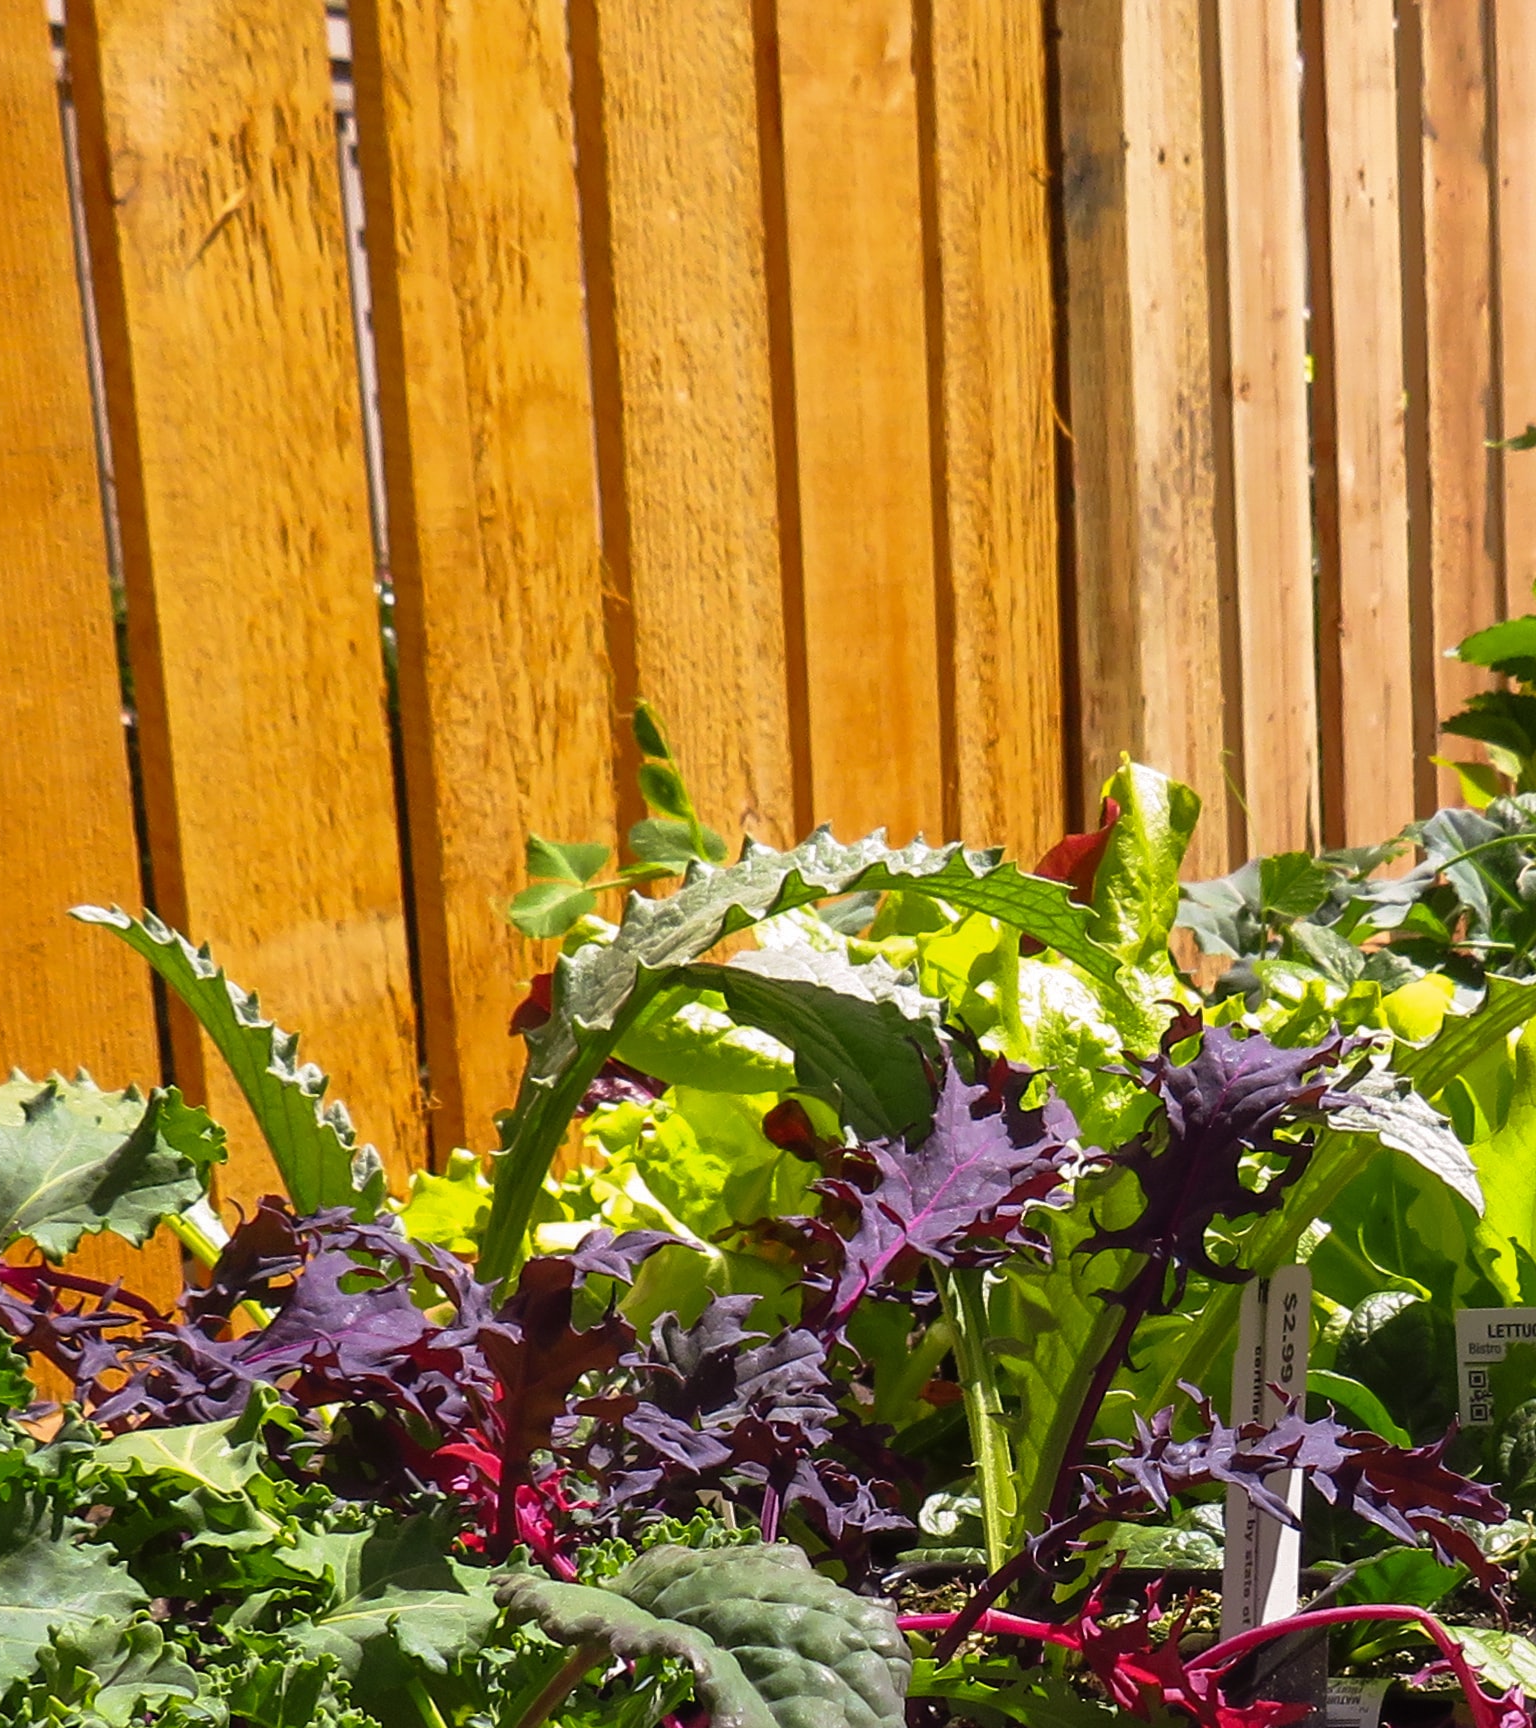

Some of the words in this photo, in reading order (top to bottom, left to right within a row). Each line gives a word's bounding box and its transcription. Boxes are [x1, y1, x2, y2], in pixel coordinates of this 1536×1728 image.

[1281, 1293, 1298, 1383] $2.99
[1468, 1342, 1502, 1355] Bistro
[1244, 1519, 1255, 1542] by
[1243, 1551, 1253, 1598] state
